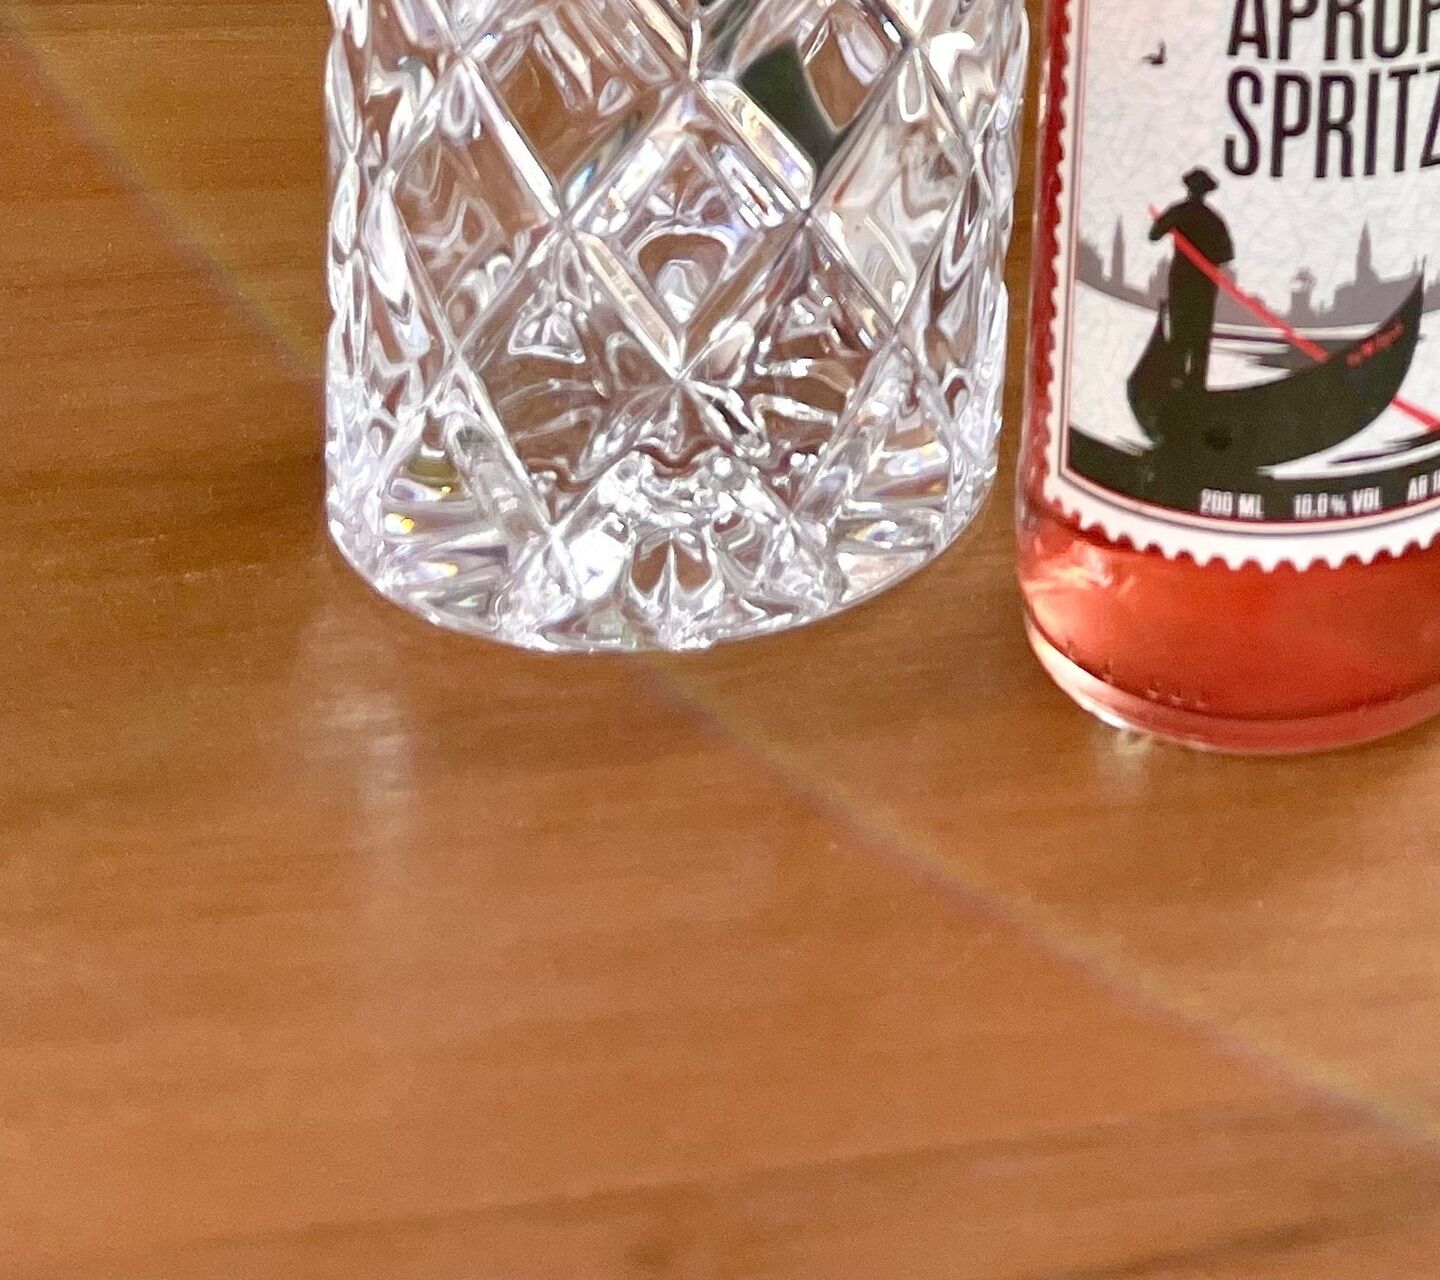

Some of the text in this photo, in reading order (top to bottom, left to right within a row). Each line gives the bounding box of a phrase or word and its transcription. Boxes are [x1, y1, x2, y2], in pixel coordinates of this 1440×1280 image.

[1200, 488, 1232, 517] 200
[1238, 493, 1264, 519] ML
[1352, 487, 1382, 514] VOL
